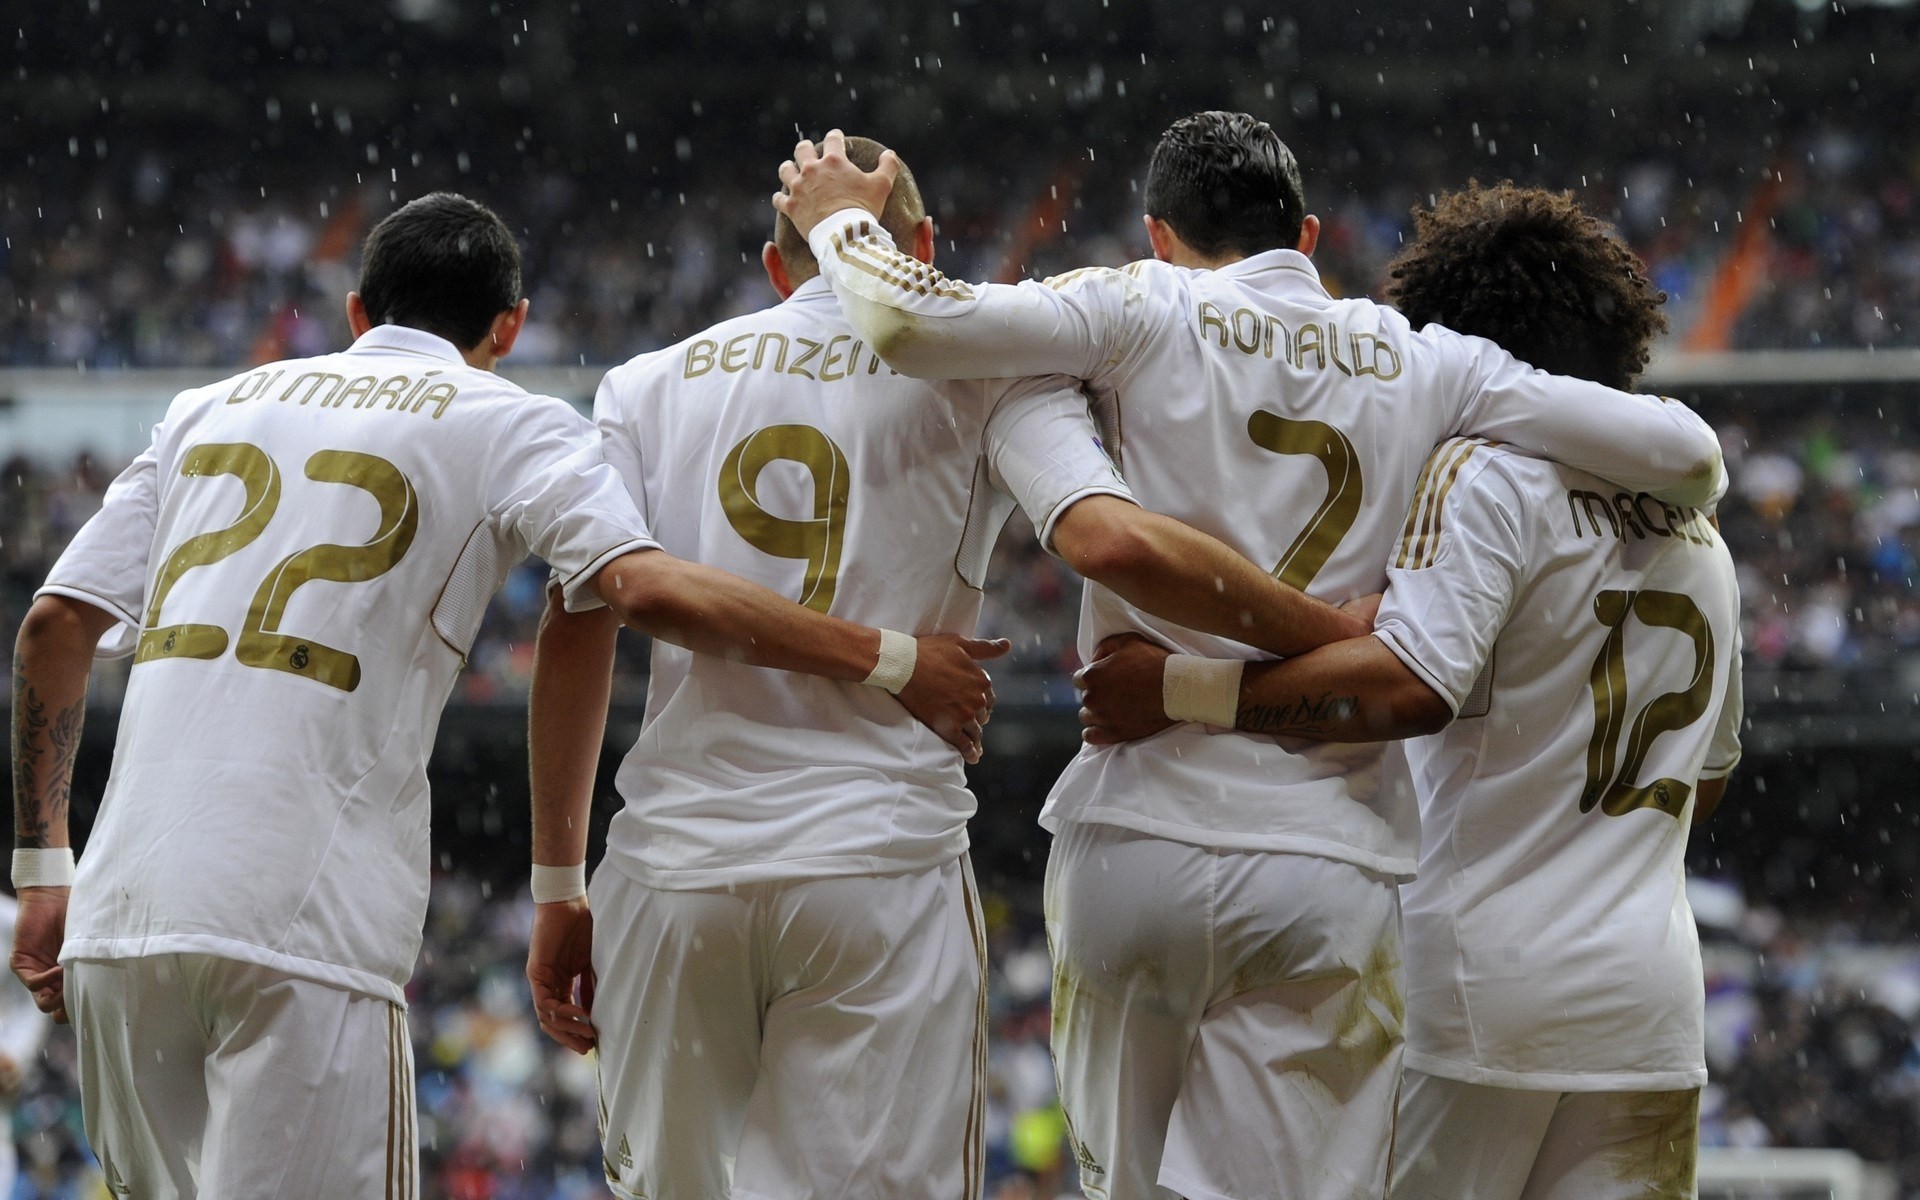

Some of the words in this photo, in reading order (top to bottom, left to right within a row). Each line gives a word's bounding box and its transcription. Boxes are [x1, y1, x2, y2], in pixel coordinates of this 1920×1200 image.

[226, 368, 285, 405] DI
[278, 369, 457, 420] MARÍA
[1198, 301, 1402, 381] RONALDO
[133, 442, 419, 693] 22
[718, 423, 850, 615] 9
[1247, 409, 1364, 592] 7
[1579, 589, 1715, 819] 12
